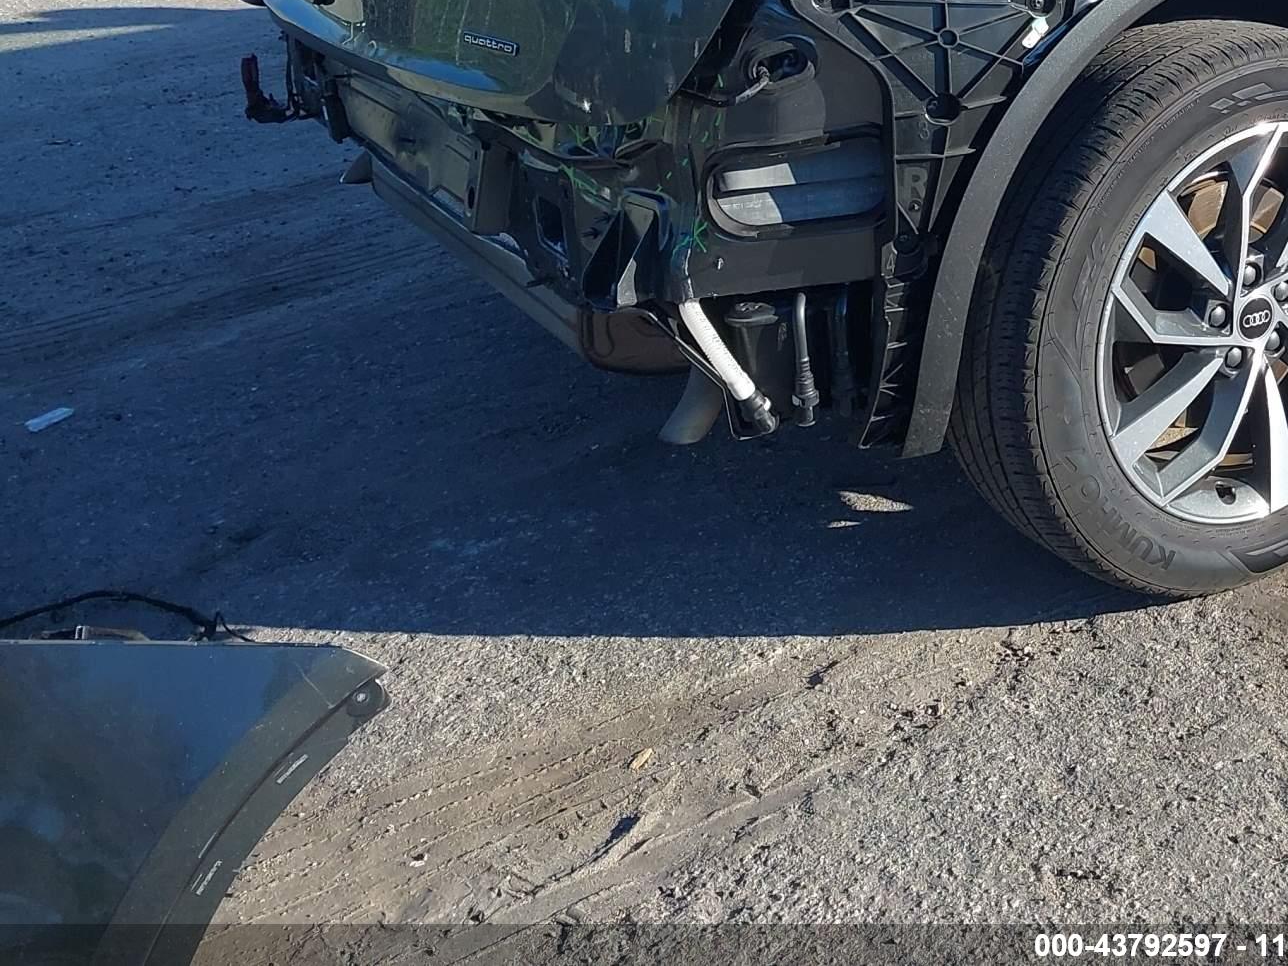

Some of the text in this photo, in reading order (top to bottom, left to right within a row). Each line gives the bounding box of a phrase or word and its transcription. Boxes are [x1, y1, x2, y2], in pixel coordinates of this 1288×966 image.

[464, 35, 513, 52] quattro
[904, 167, 927, 198] R
[1078, 472, 1177, 570] KUMHO
